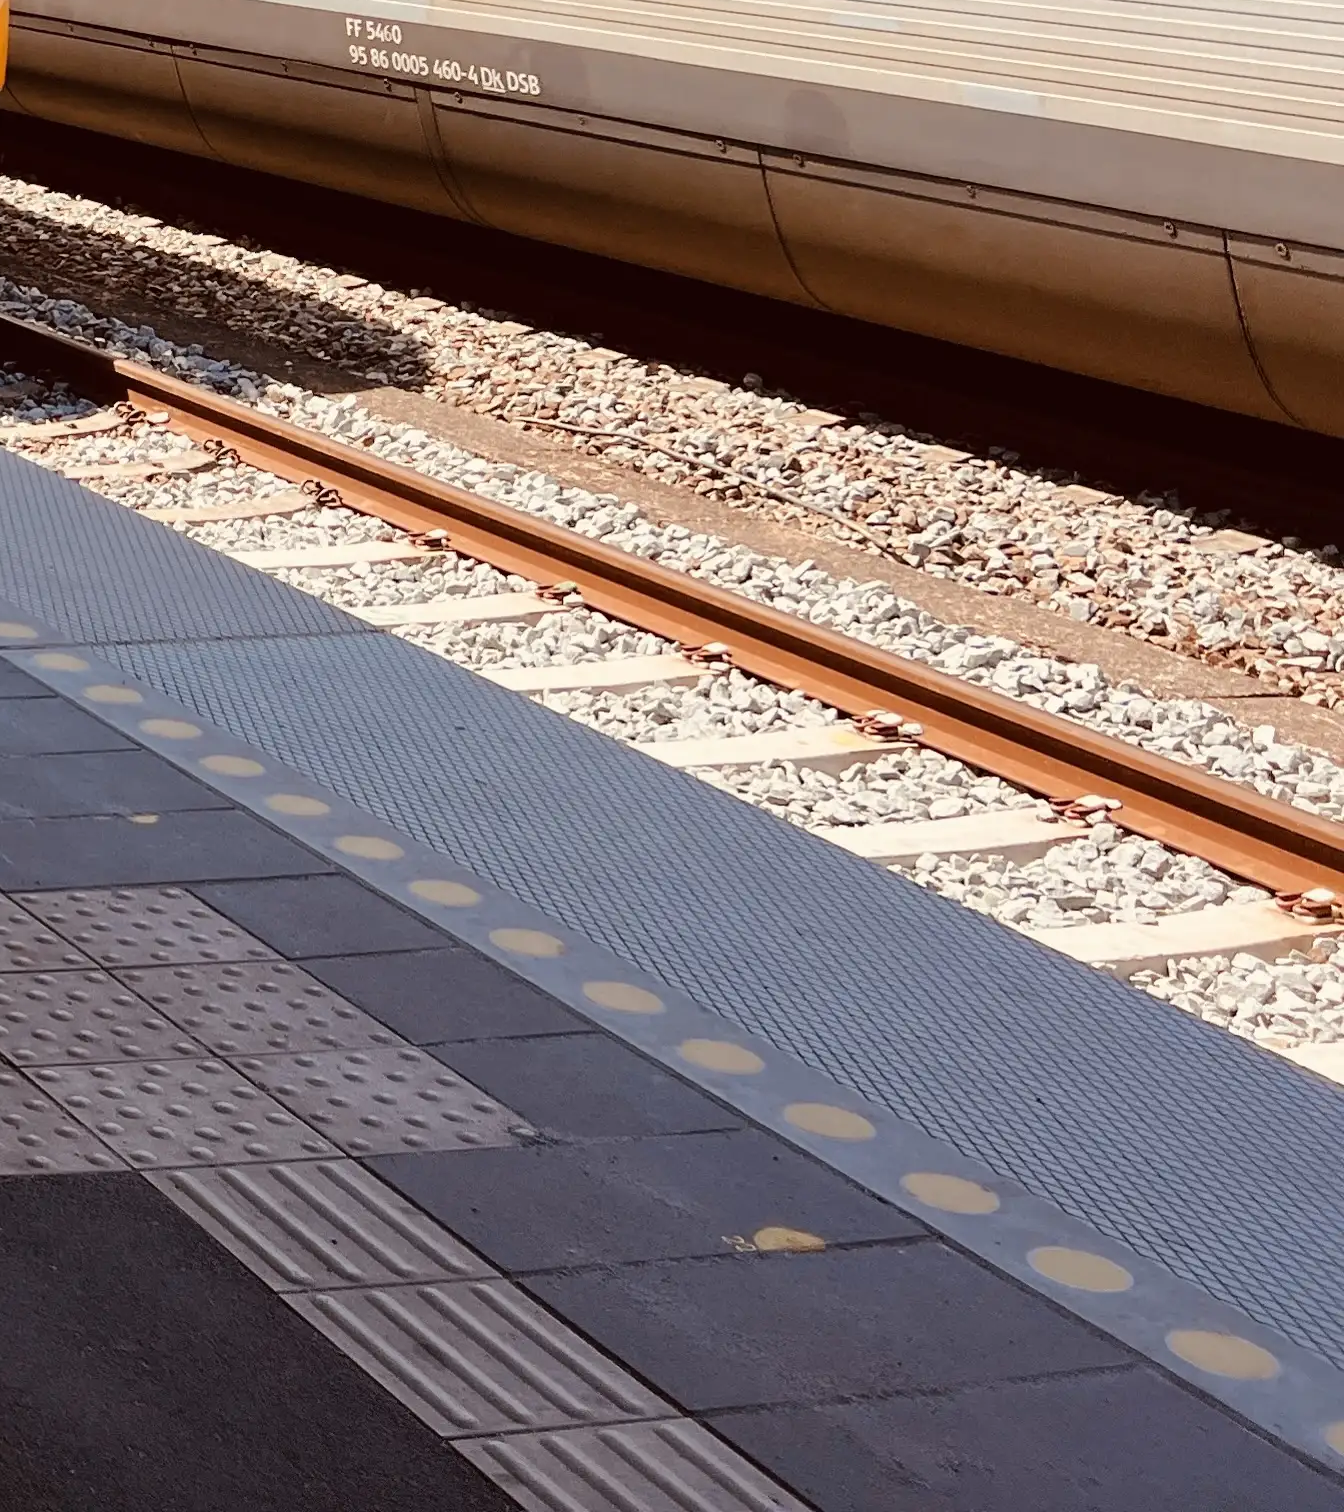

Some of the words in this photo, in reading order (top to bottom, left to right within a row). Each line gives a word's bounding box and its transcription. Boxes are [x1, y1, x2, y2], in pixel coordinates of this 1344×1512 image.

[345, 17, 363, 38] FF
[365, 20, 403, 45] 5460
[349, 44, 368, 66] 95
[370, 48, 390, 70] 86
[392, 51, 429, 77] 0005
[433, 59, 479, 85] 460-4
[506, 70, 542, 96] DSB
